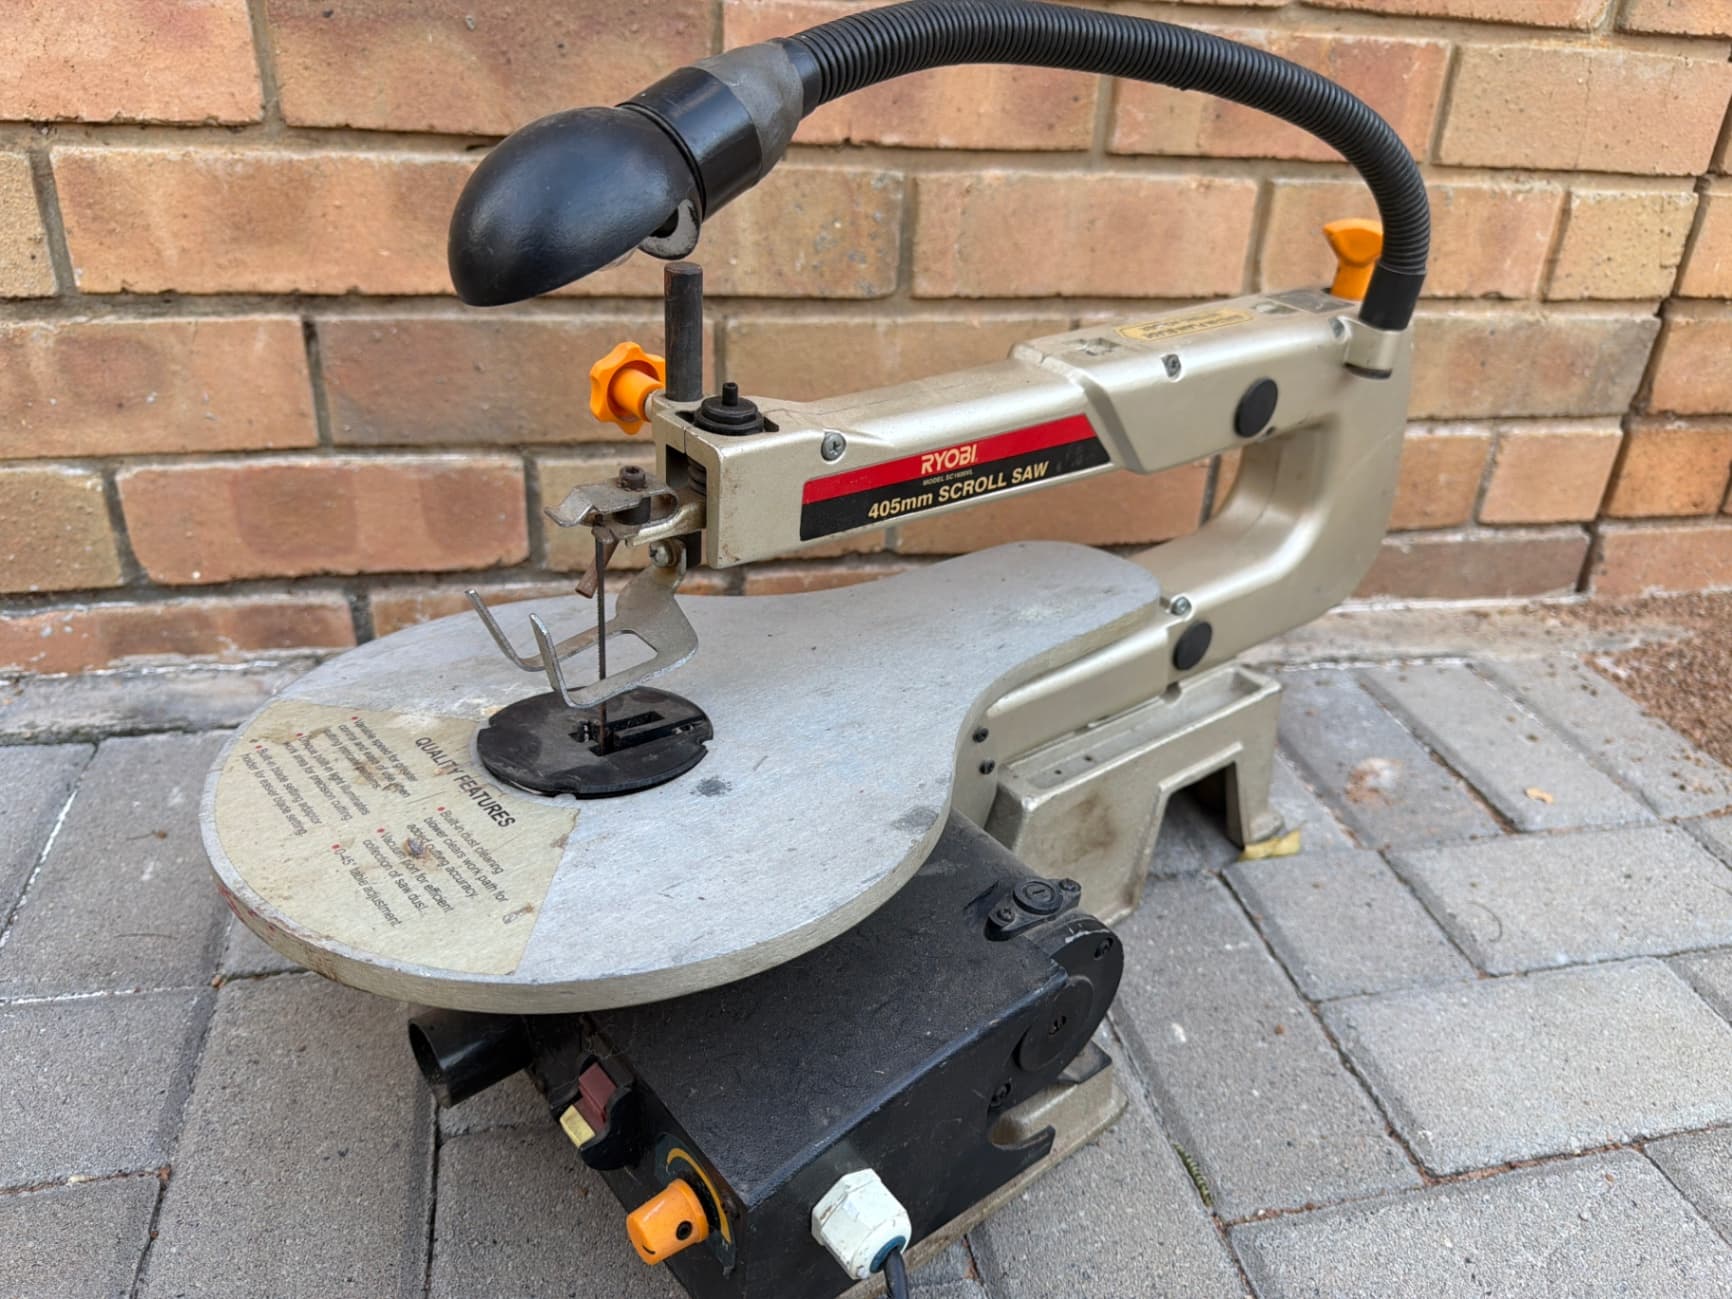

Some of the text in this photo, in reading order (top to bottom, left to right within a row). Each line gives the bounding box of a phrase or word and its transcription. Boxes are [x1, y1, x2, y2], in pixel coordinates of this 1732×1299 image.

[921, 444, 977, 474] RYOBI
[868, 493, 933, 518] 405mm
[938, 472, 1007, 502] SCROLL
[1011, 460, 1049, 484] SAW
[416, 736, 516, 828] QUALITY FEATURES
[460, 831, 481, 849] dust
[395, 878, 411, 894] saw
[415, 872, 430, 884] for
[462, 858, 481, 876] work
[475, 874, 498, 894] path
[492, 890, 509, 903] for
